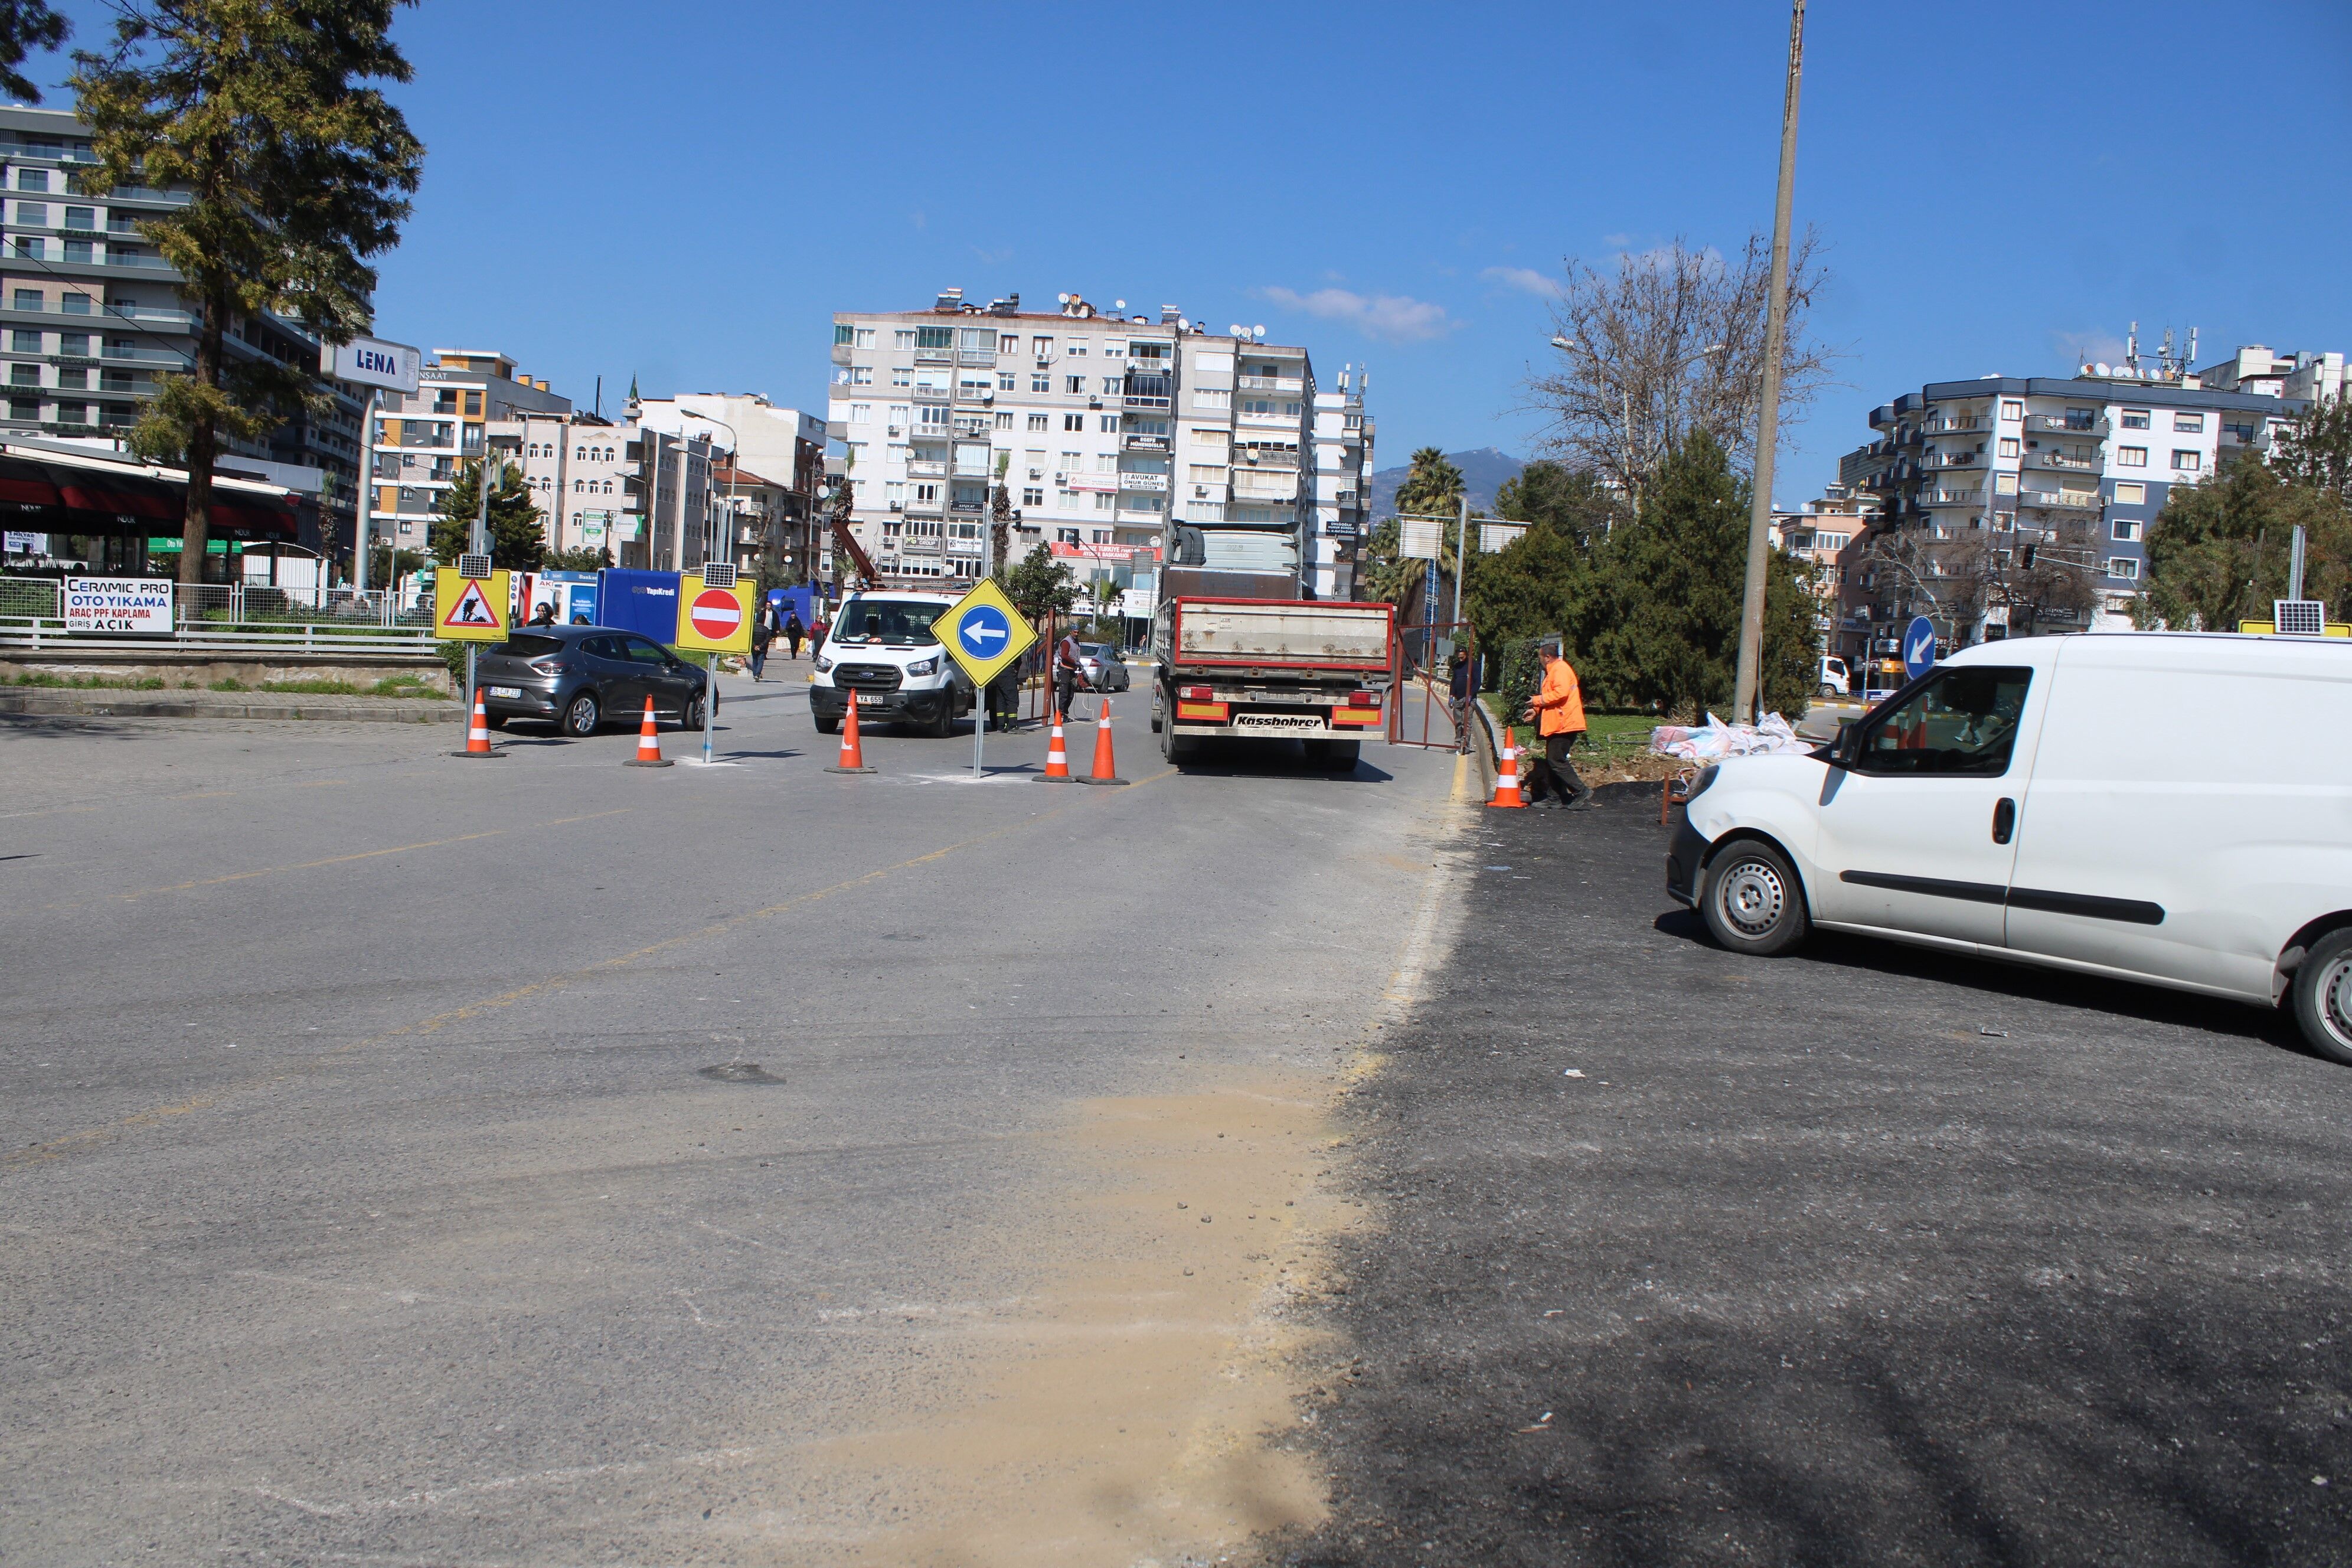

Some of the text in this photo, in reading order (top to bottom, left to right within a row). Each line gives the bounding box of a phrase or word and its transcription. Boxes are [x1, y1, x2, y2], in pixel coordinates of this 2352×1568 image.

[357, 349, 396, 375] LENA
[420, 371, 447, 381] NŞAAT
[68, 579, 169, 593] CERAMIC PRO
[646, 587, 674, 596] YapıKredi
[71, 595, 167, 607] OTO YIKAMA
[70, 608, 151, 619] ARAÇ PPF KAPLAMA
[69, 620, 134, 630] GİRİŞ AÇIK
[1237, 716, 1321, 727] Kässbohrer
